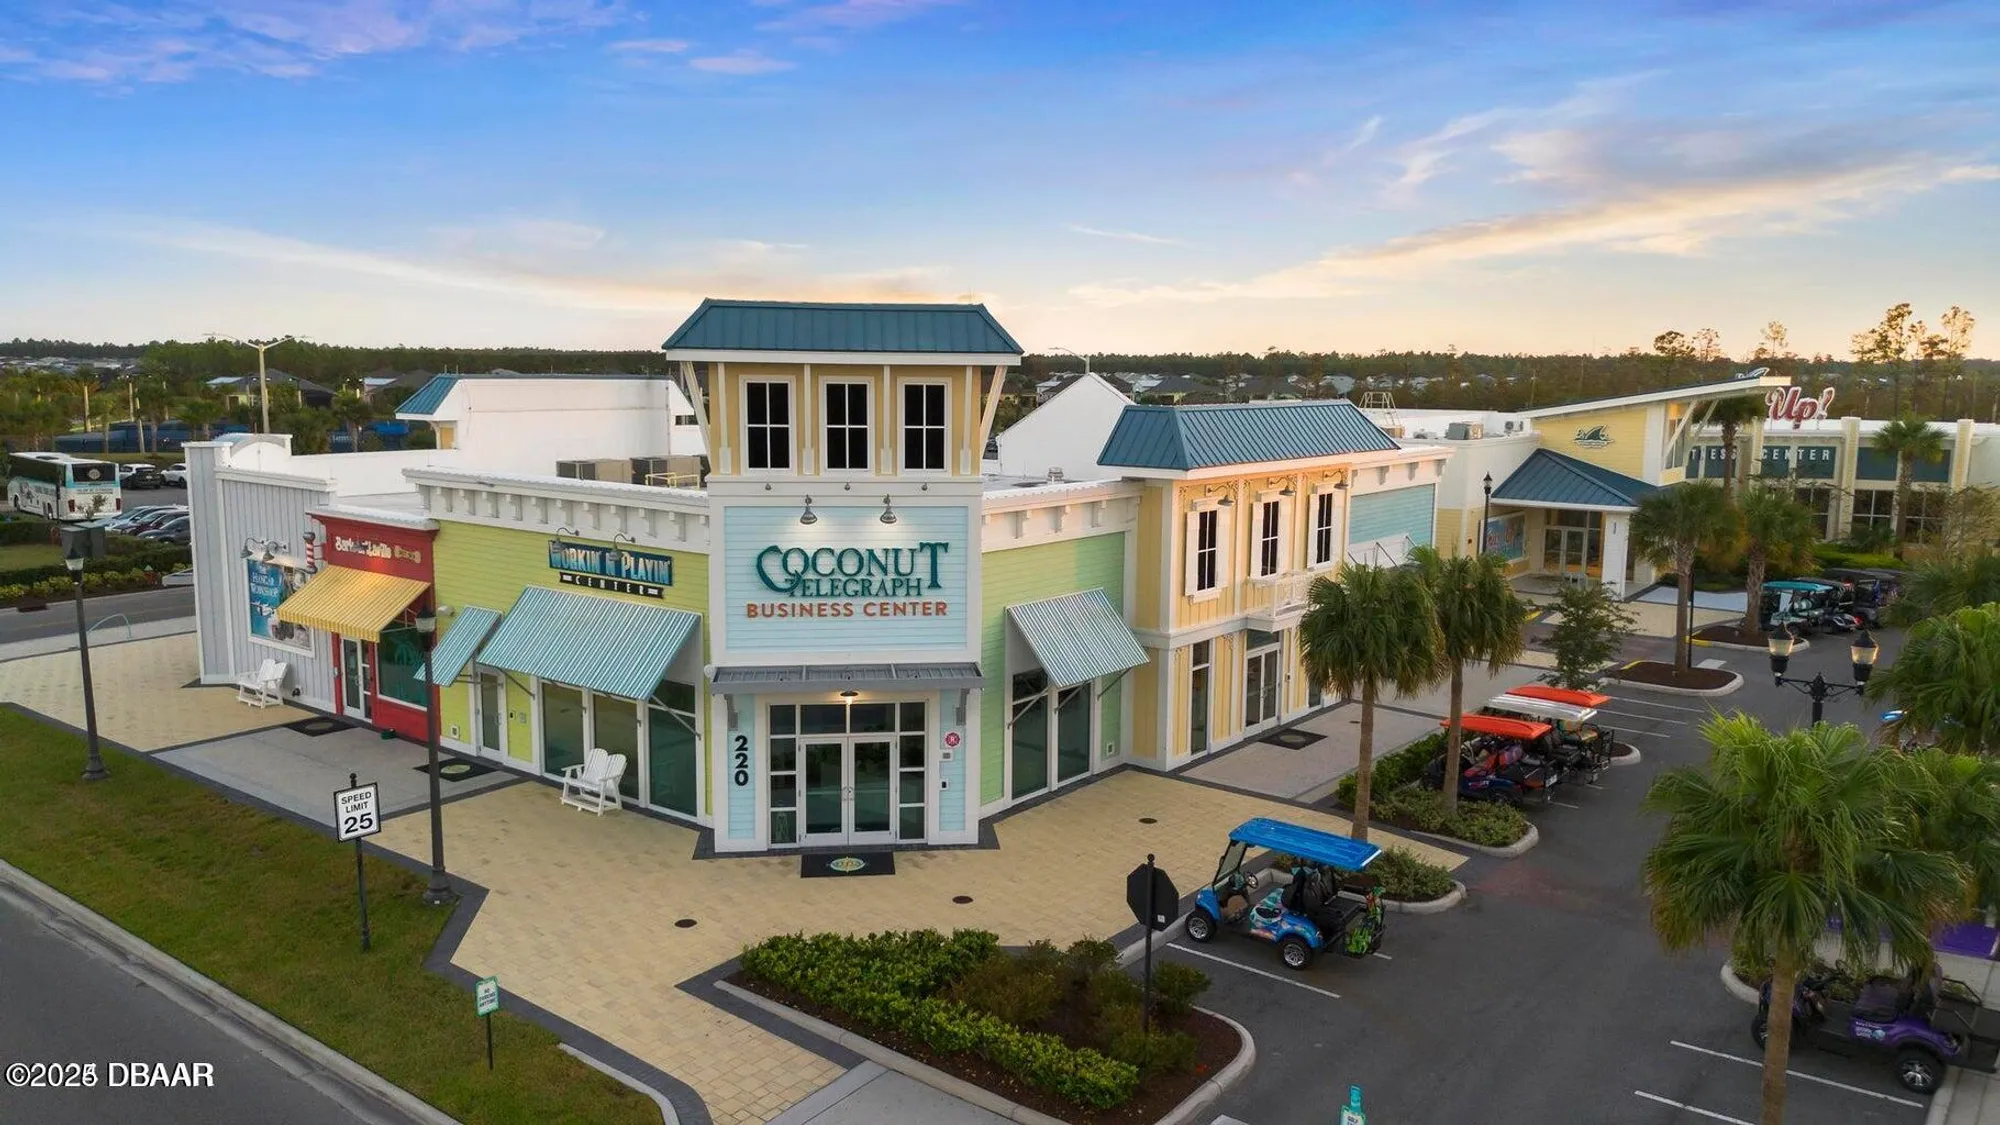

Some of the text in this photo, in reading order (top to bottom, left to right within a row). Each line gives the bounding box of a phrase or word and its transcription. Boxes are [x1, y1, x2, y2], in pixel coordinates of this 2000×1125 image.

[1765, 386, 1835, 429] Up!
[1761, 448, 1830, 461] CENTER
[756, 542, 949, 592] COCONUT
[575, 575, 645, 595] CENTER
[785, 578, 922, 597] TELEGRAPH
[747, 601, 948, 618] BUSINESS CENTER
[734, 735, 749, 786] 220
[341, 791, 372, 805] SPEED
[345, 801, 369, 814] LIMIT
[344, 812, 373, 834] 25
